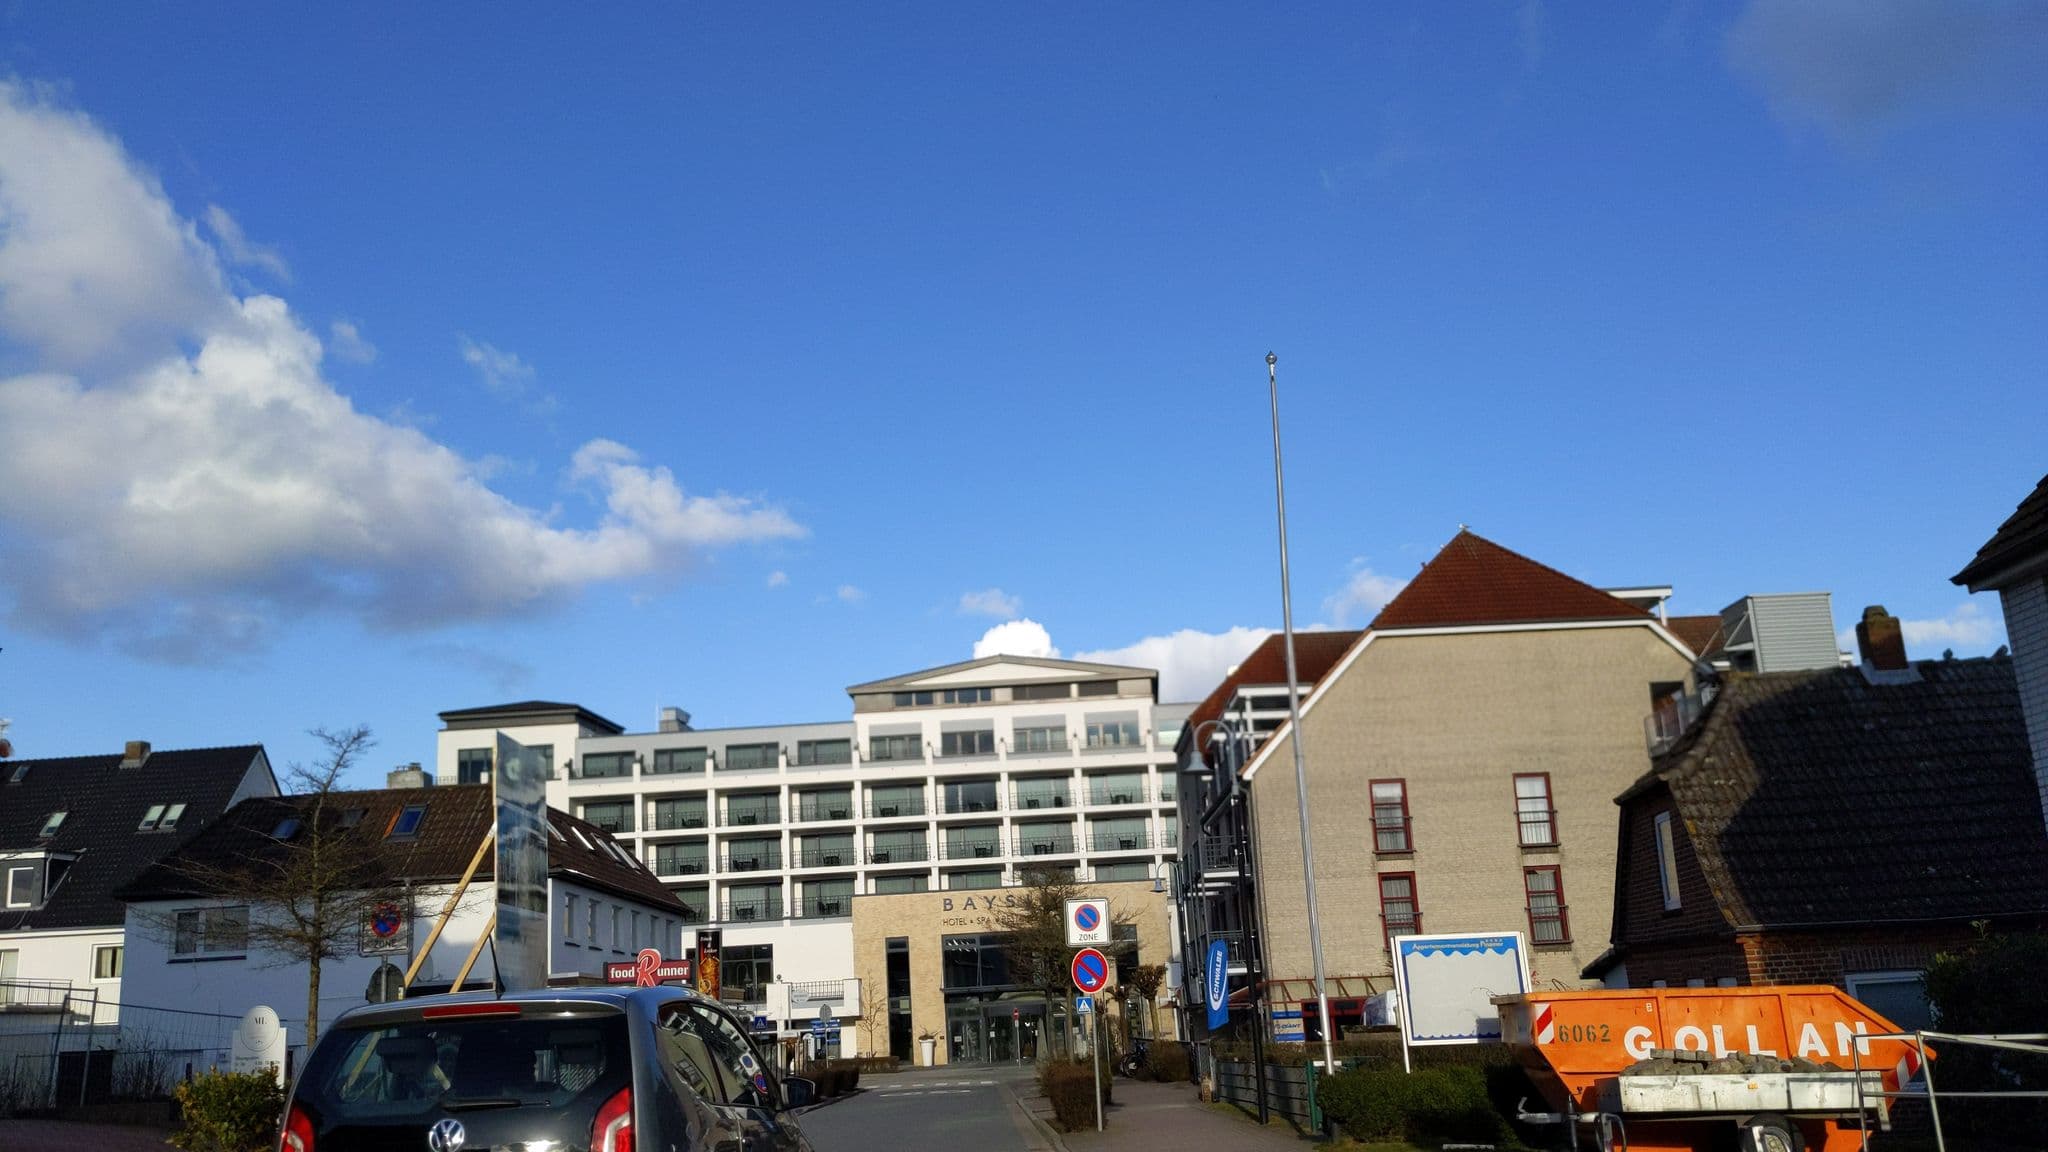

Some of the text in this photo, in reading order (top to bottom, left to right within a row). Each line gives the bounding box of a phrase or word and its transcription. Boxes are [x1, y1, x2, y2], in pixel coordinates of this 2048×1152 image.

[943, 917, 968, 927] HOTEL
[1078, 933, 1099, 942] ZONE
[610, 966, 635, 979] food
[1213, 950, 1223, 1001] SCHWALBE
[1558, 1021, 1871, 1061] 6062 GOLLAN
